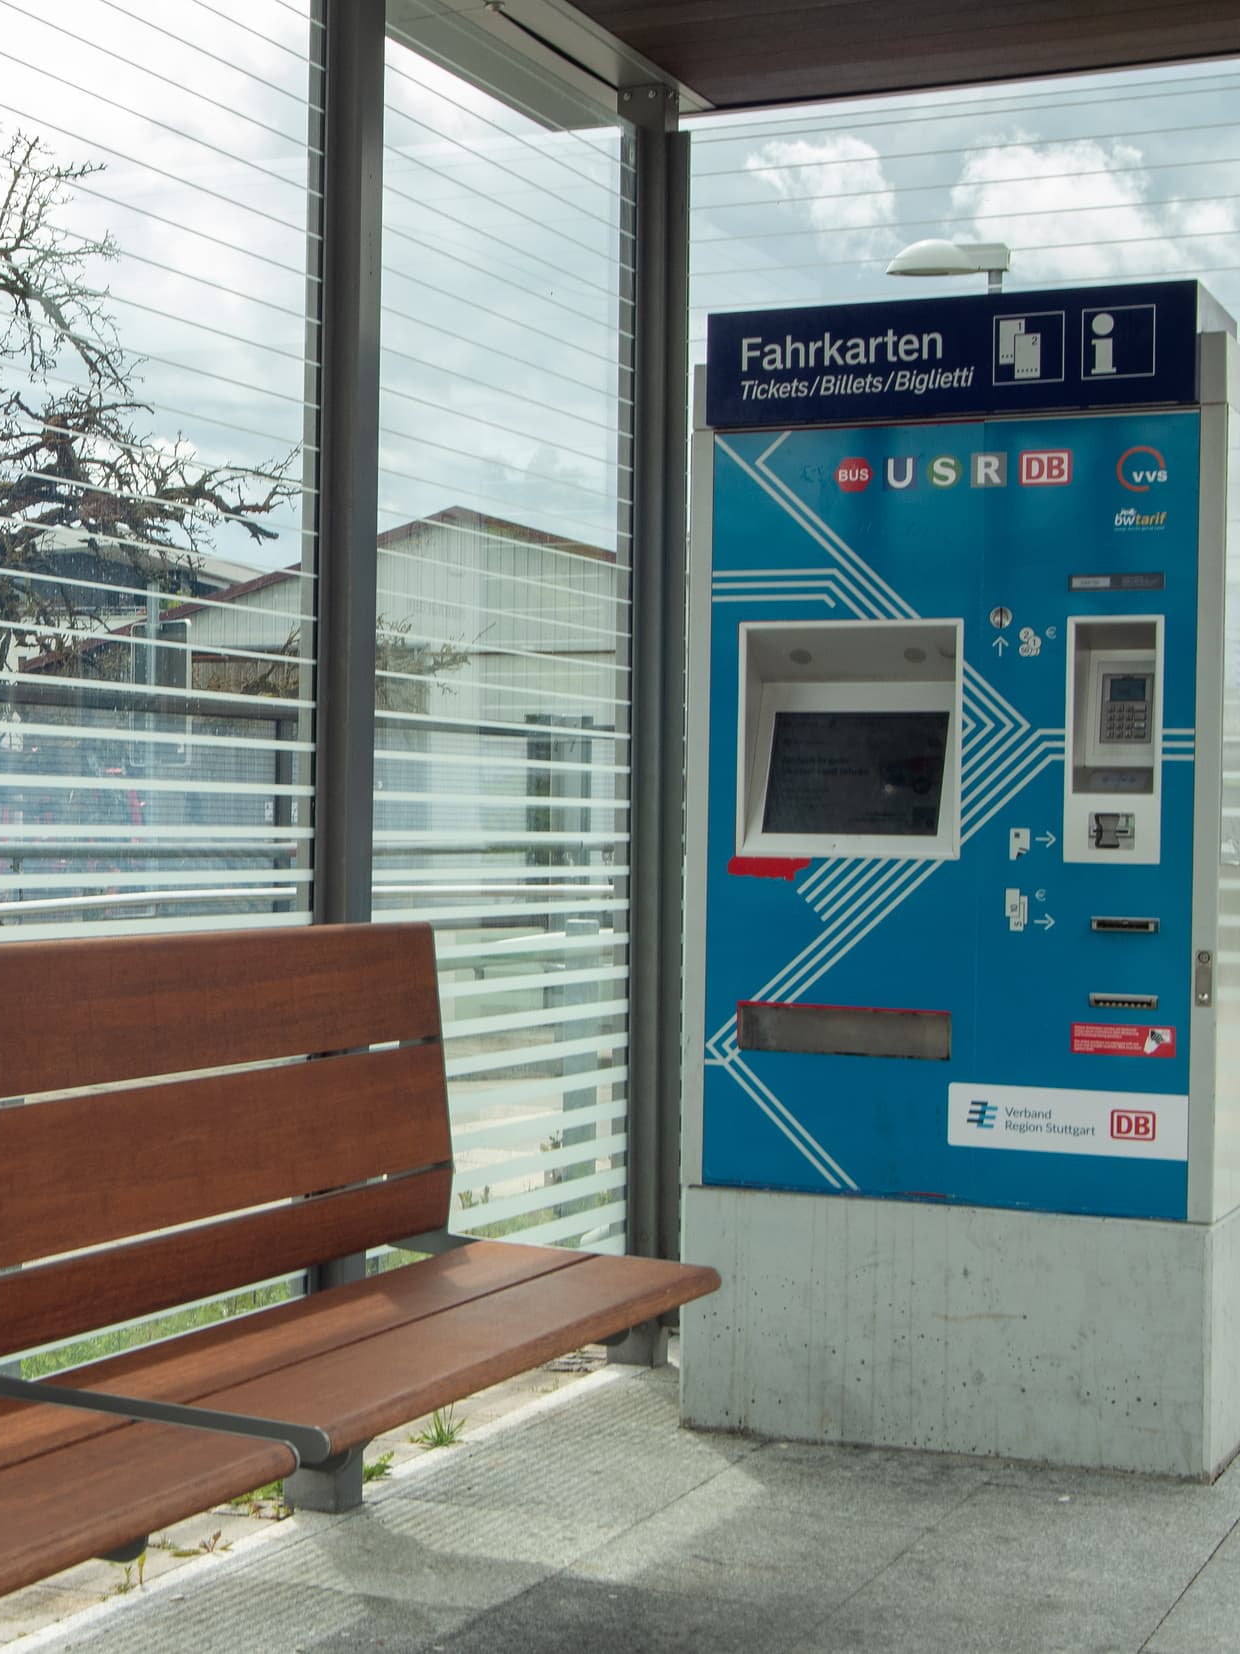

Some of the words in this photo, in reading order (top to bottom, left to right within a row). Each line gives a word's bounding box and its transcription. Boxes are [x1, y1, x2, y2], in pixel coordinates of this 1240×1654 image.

[741, 328, 944, 372] Fahrkarten
[838, 468, 870, 482] BUS
[887, 456, 914, 489] U
[932, 456, 957, 487] S
[976, 454, 1002, 485] R
[1024, 455, 1067, 482] DB
[1004, 1106, 1053, 1120] Verband
[1004, 1120, 1043, 1134] Region
[1045, 1123, 1096, 1137] Stuttgart
[1115, 1114, 1151, 1137] DB
